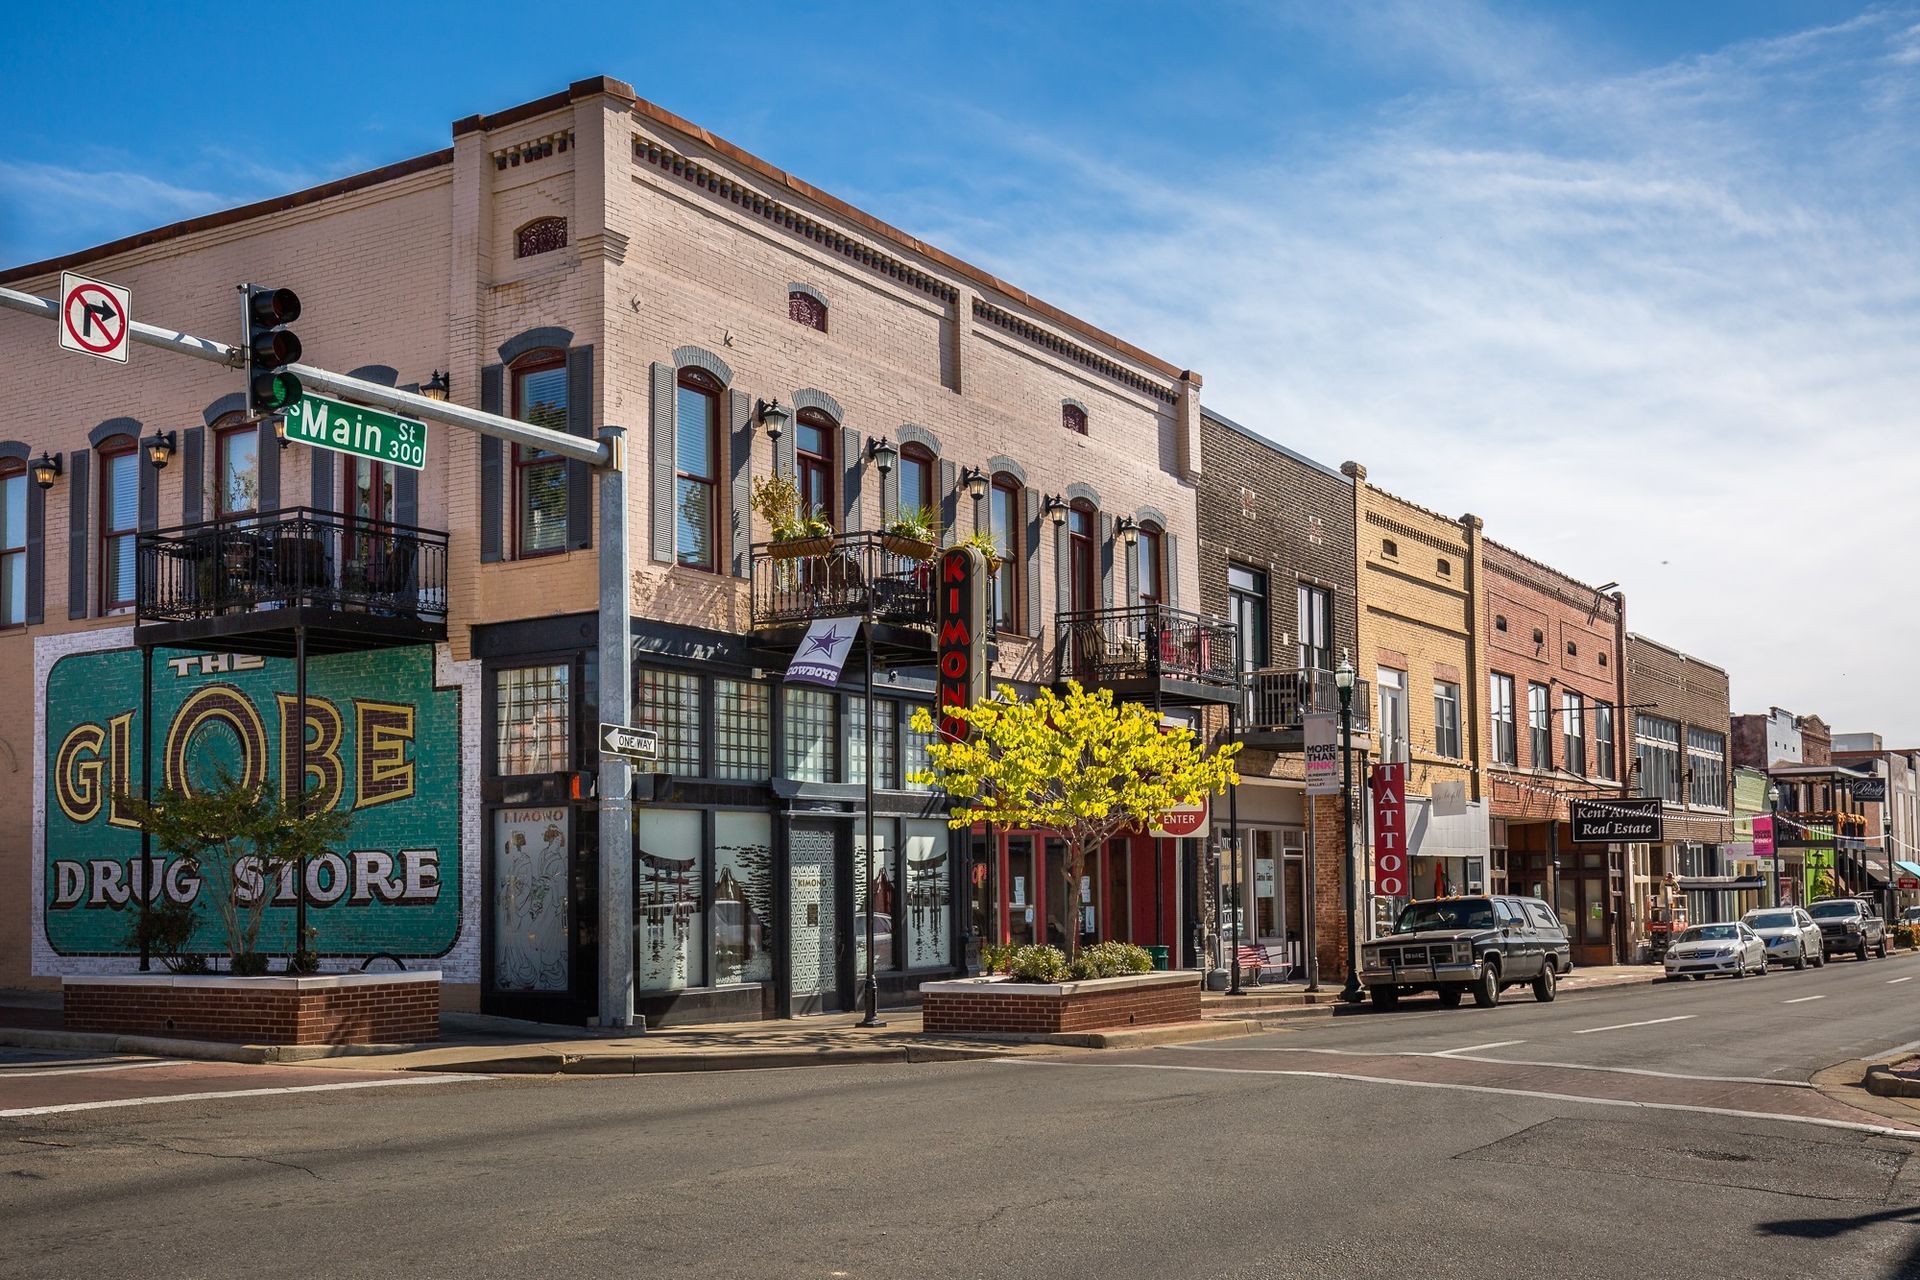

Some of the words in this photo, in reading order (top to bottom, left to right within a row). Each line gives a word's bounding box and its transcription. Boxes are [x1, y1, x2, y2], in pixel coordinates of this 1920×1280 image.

[301, 400, 382, 453] Main
[399, 422, 416, 443] St
[389, 440, 422, 464] 300
[939, 555, 970, 743] KIMONO
[168, 653, 267, 677] THE
[786, 666, 838, 682] COWBOYS
[618, 735, 635, 748] ONE
[636, 738, 653, 751] WAY
[1306, 743, 1336, 754] MORE
[54, 682, 416, 841] GLOBE
[1306, 752, 1336, 762] THAN
[503, 810, 564, 824] KIMONO
[1163, 814, 1196, 825] ENTER
[1576, 806, 1607, 819] Kent
[1379, 764, 1402, 894] TATTOO
[1581, 821, 1613, 835] Real
[1613, 823, 1652, 835] Estate
[50, 857, 201, 909] DRUG
[233, 849, 442, 907] STORE
[797, 878, 827, 888] KIMONO
[1404, 952, 1425, 960] GMC
